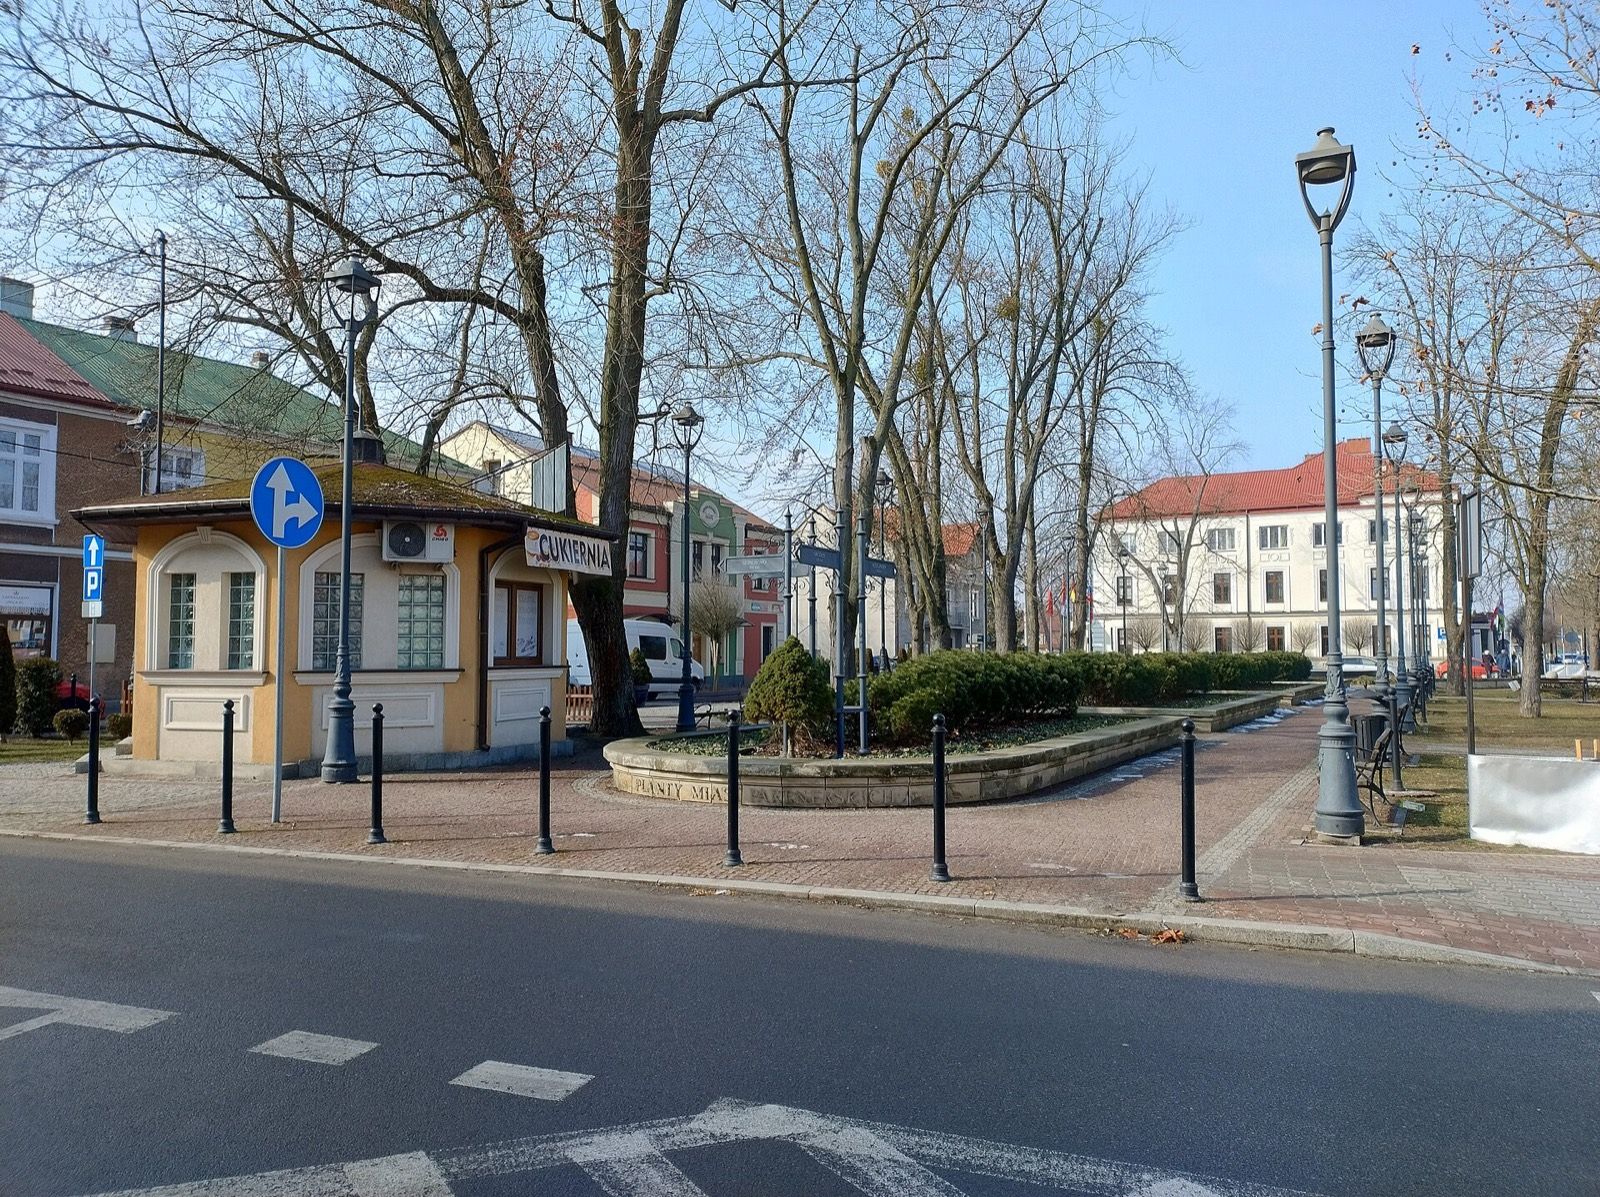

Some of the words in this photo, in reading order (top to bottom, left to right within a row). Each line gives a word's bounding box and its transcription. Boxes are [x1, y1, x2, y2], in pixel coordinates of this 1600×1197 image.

[539, 534, 611, 569] CUKIERNIA
[87, 571, 98, 597] P
[635, 779, 683, 801] PLANTY
[692, 785, 728, 802] MIAS
